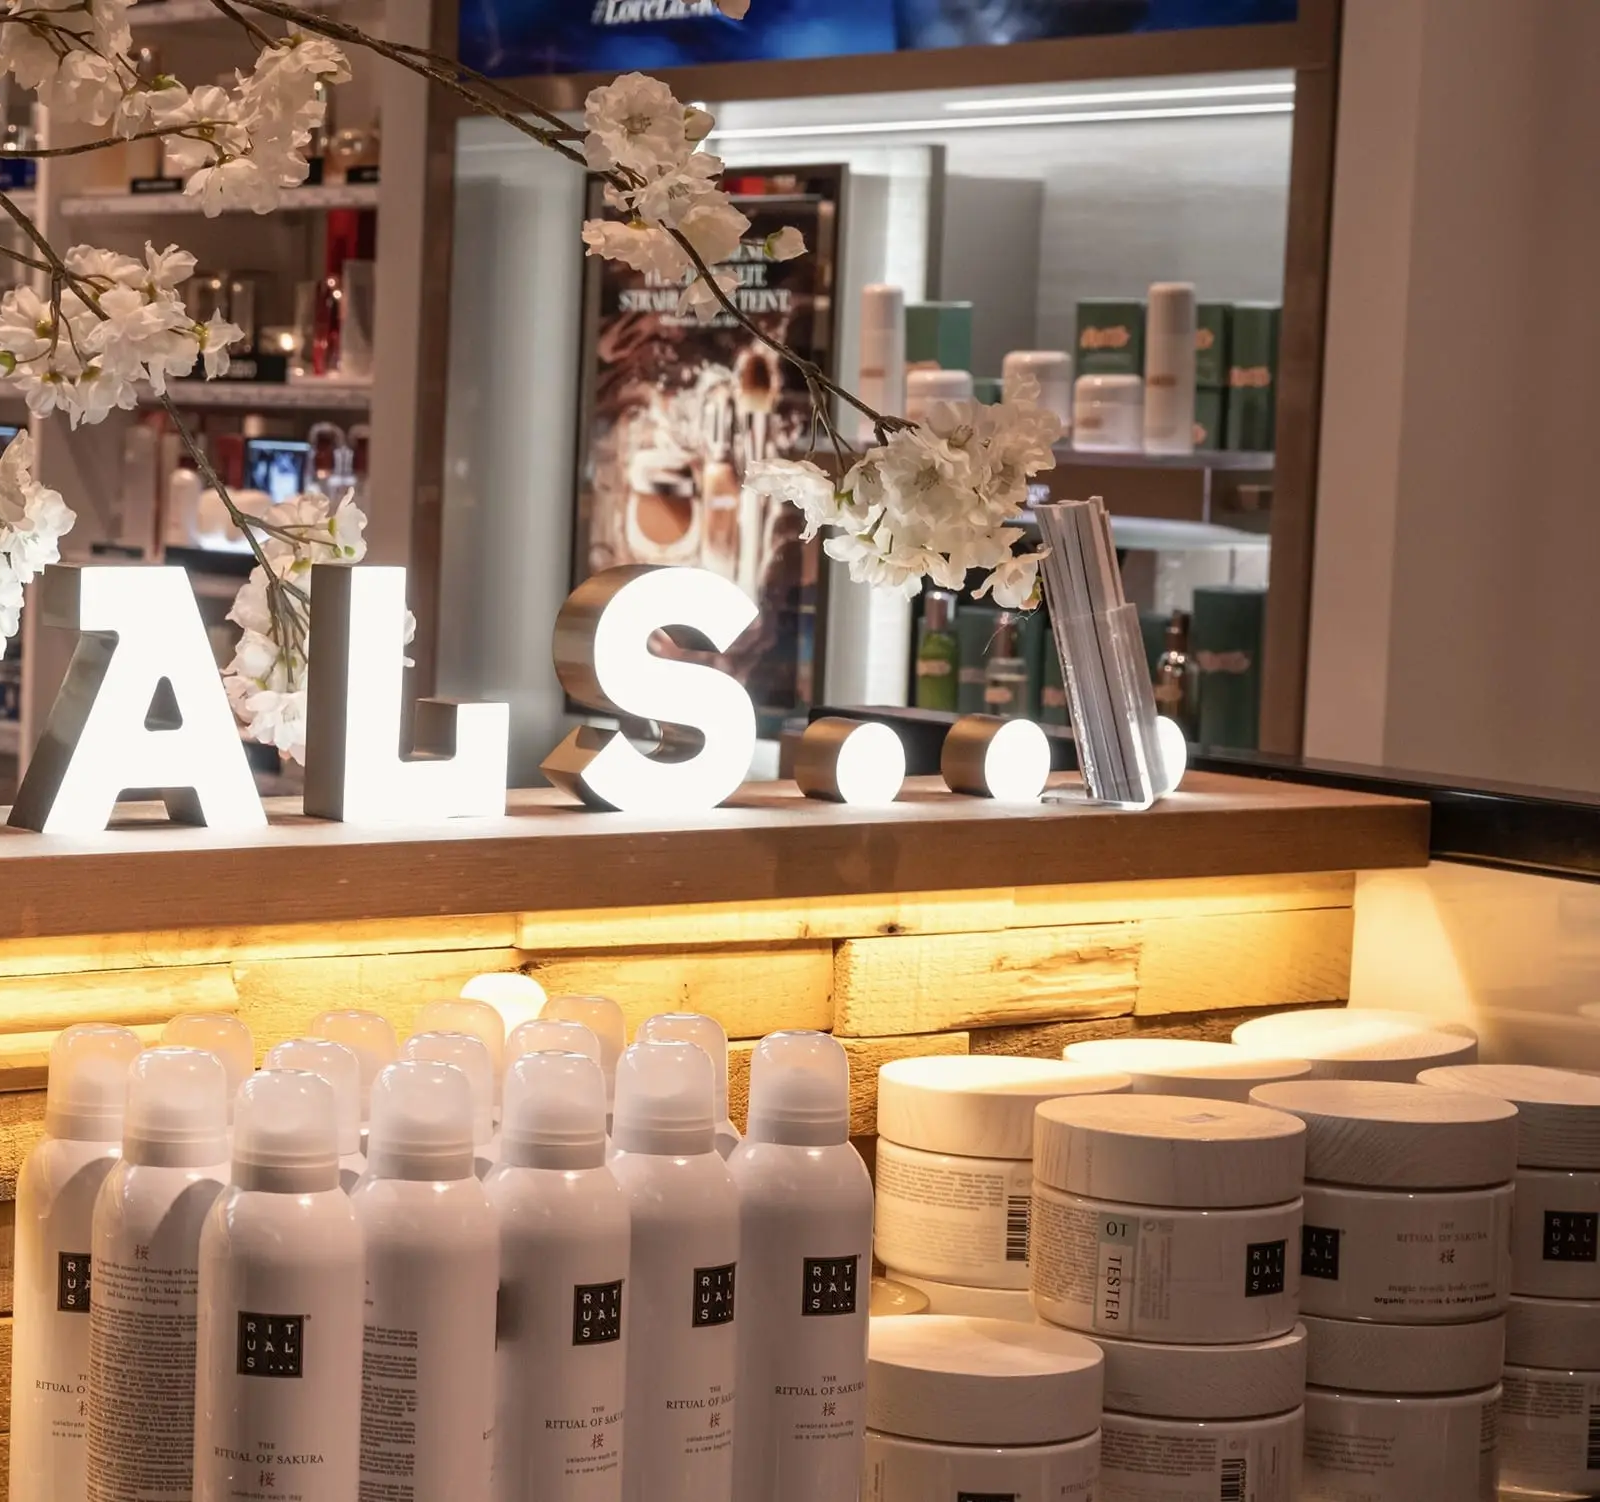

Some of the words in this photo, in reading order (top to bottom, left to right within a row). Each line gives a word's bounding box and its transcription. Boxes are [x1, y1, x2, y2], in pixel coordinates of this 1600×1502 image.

[1105, 1255, 1122, 1320] TESTER
[35, 1380, 74, 1394] RITUAL
[775, 1386, 817, 1396] RITUAL
[820, 1386, 835, 1396] OF
[666, 1399, 706, 1409] RITUAL
[708, 1397, 720, 1407] OF
[822, 1401, 836, 1417] 桜
[545, 1418, 587, 1430] RITUAL
[590, 1416, 603, 1427] OF
[709, 1412, 721, 1429] 桜
[591, 1433, 604, 1449] 桜
[214, 1446, 252, 1463] RITUAL
[256, 1454, 273, 1464] OF
[277, 1453, 324, 1465] SAKURA
[259, 1470, 277, 1487] 桜
